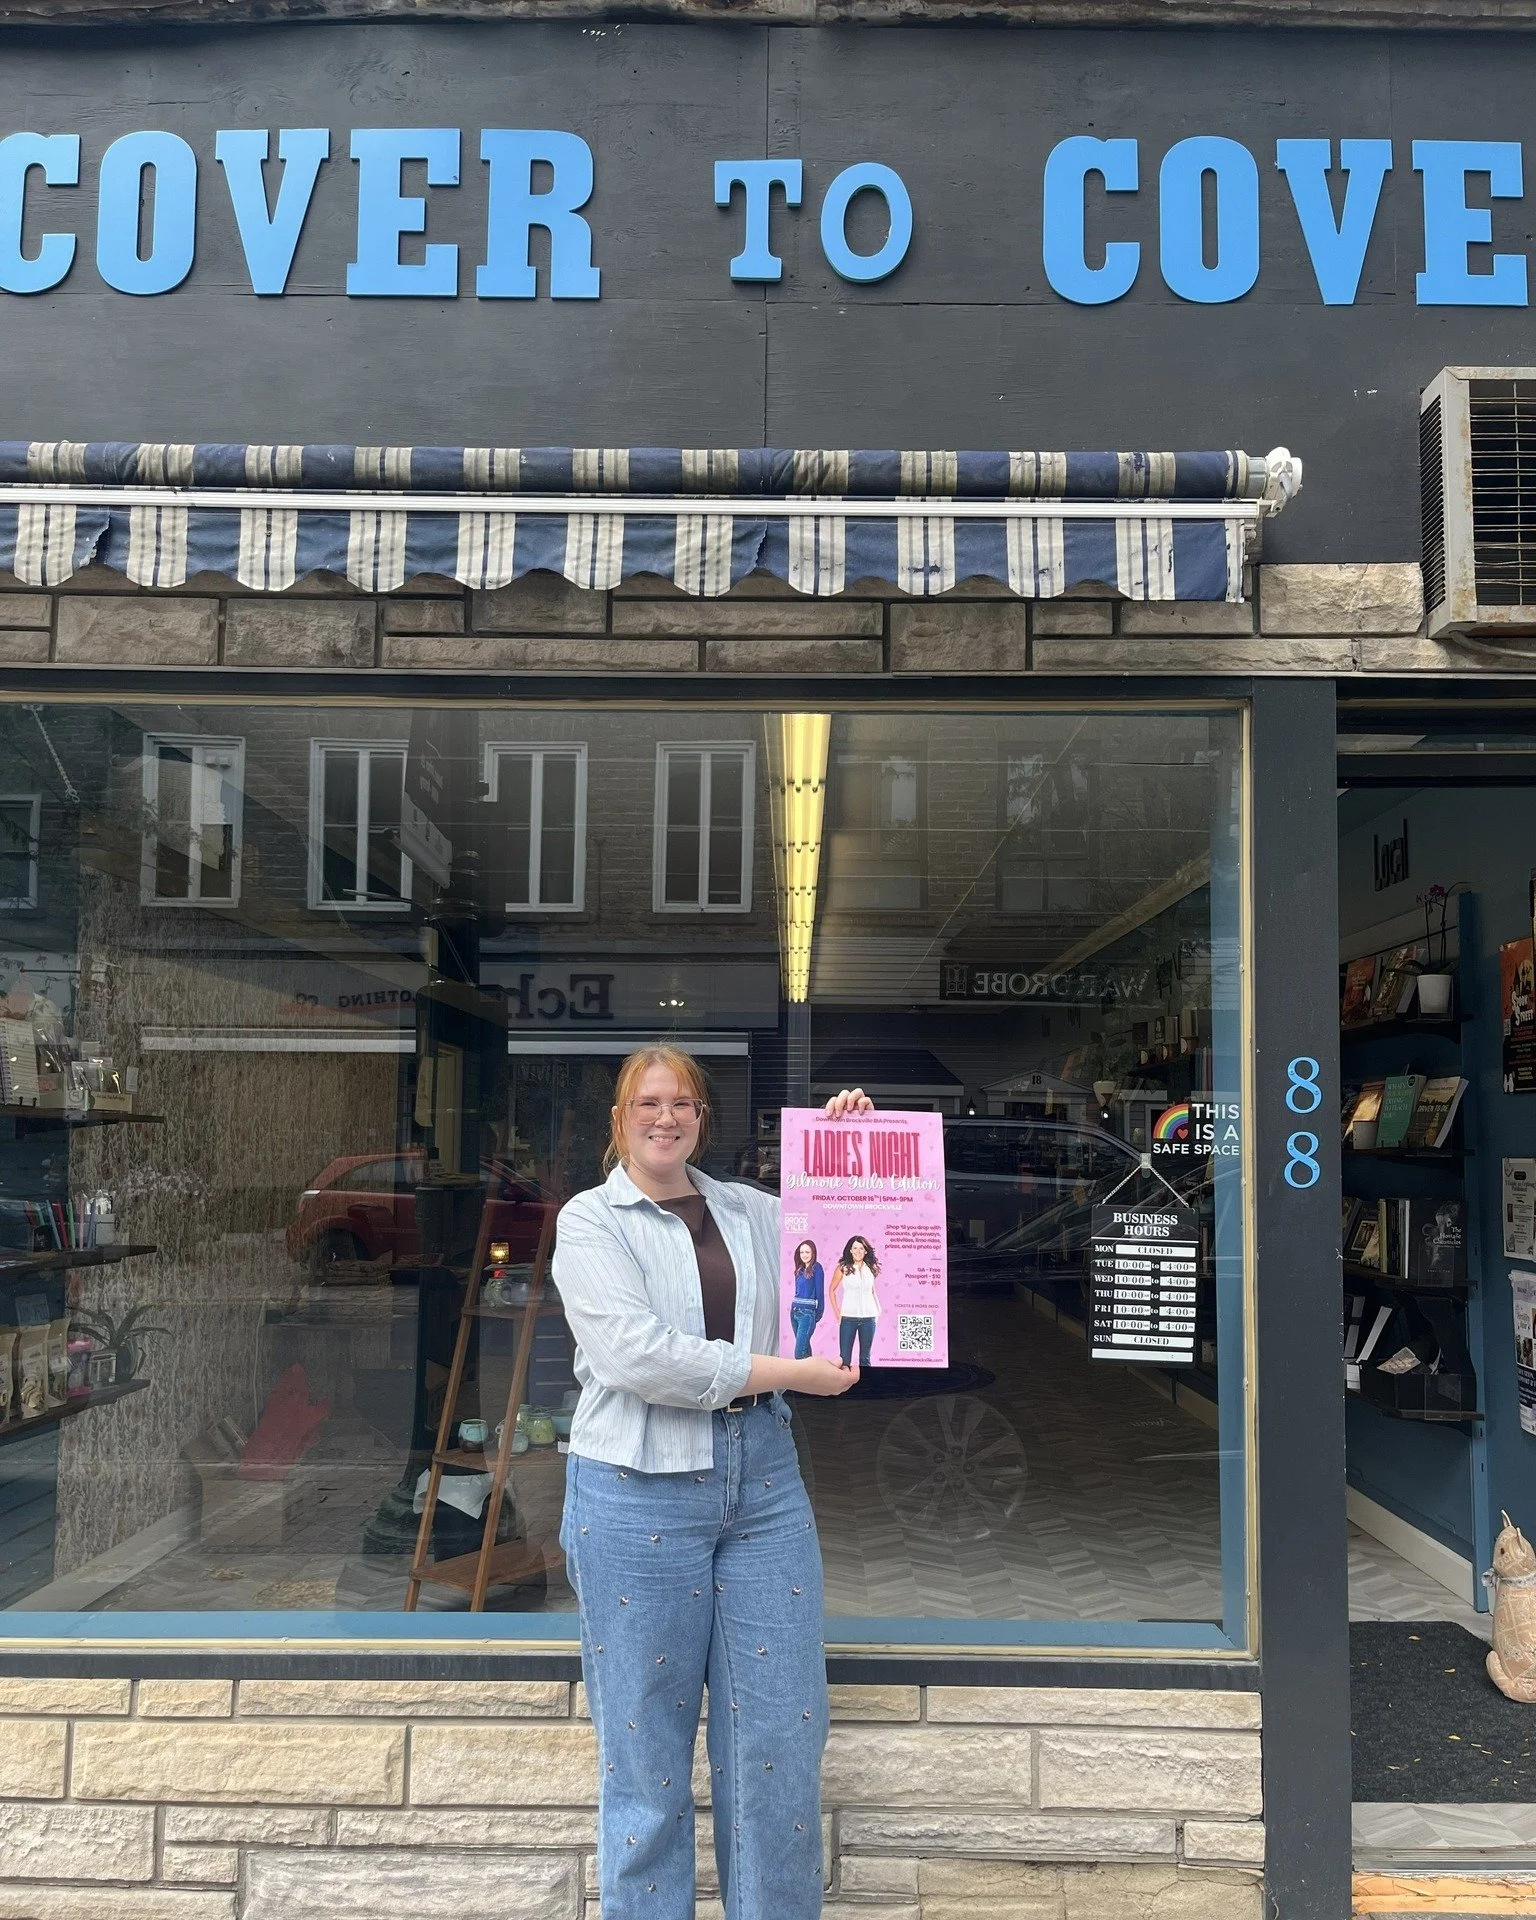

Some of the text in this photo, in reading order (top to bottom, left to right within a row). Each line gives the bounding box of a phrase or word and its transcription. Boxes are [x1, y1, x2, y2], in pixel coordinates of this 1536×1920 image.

[0, 128, 602, 299] COVER
[713, 158, 914, 284] TO
[1192, 1103, 1239, 1119] THIS
[1195, 1123, 1239, 1140] IS A
[804, 1129, 920, 1179] LADIES NIGHT
[1152, 1143, 1239, 1155] SAFE SPACE
[890, 1174, 941, 1192] Edition
[785, 1216, 808, 1225] BROCK
[1113, 1212, 1178, 1225] BUSINESS
[1124, 1225, 1170, 1237] HOURS
[1094, 1244, 1173, 1255] MON CLOSED
[1095, 1260, 1113, 1268] TUE
[1094, 1289, 1113, 1297] THU
[1094, 1304, 1111, 1312] FRI
[1093, 1334, 1169, 1345] SUN CLOSED
